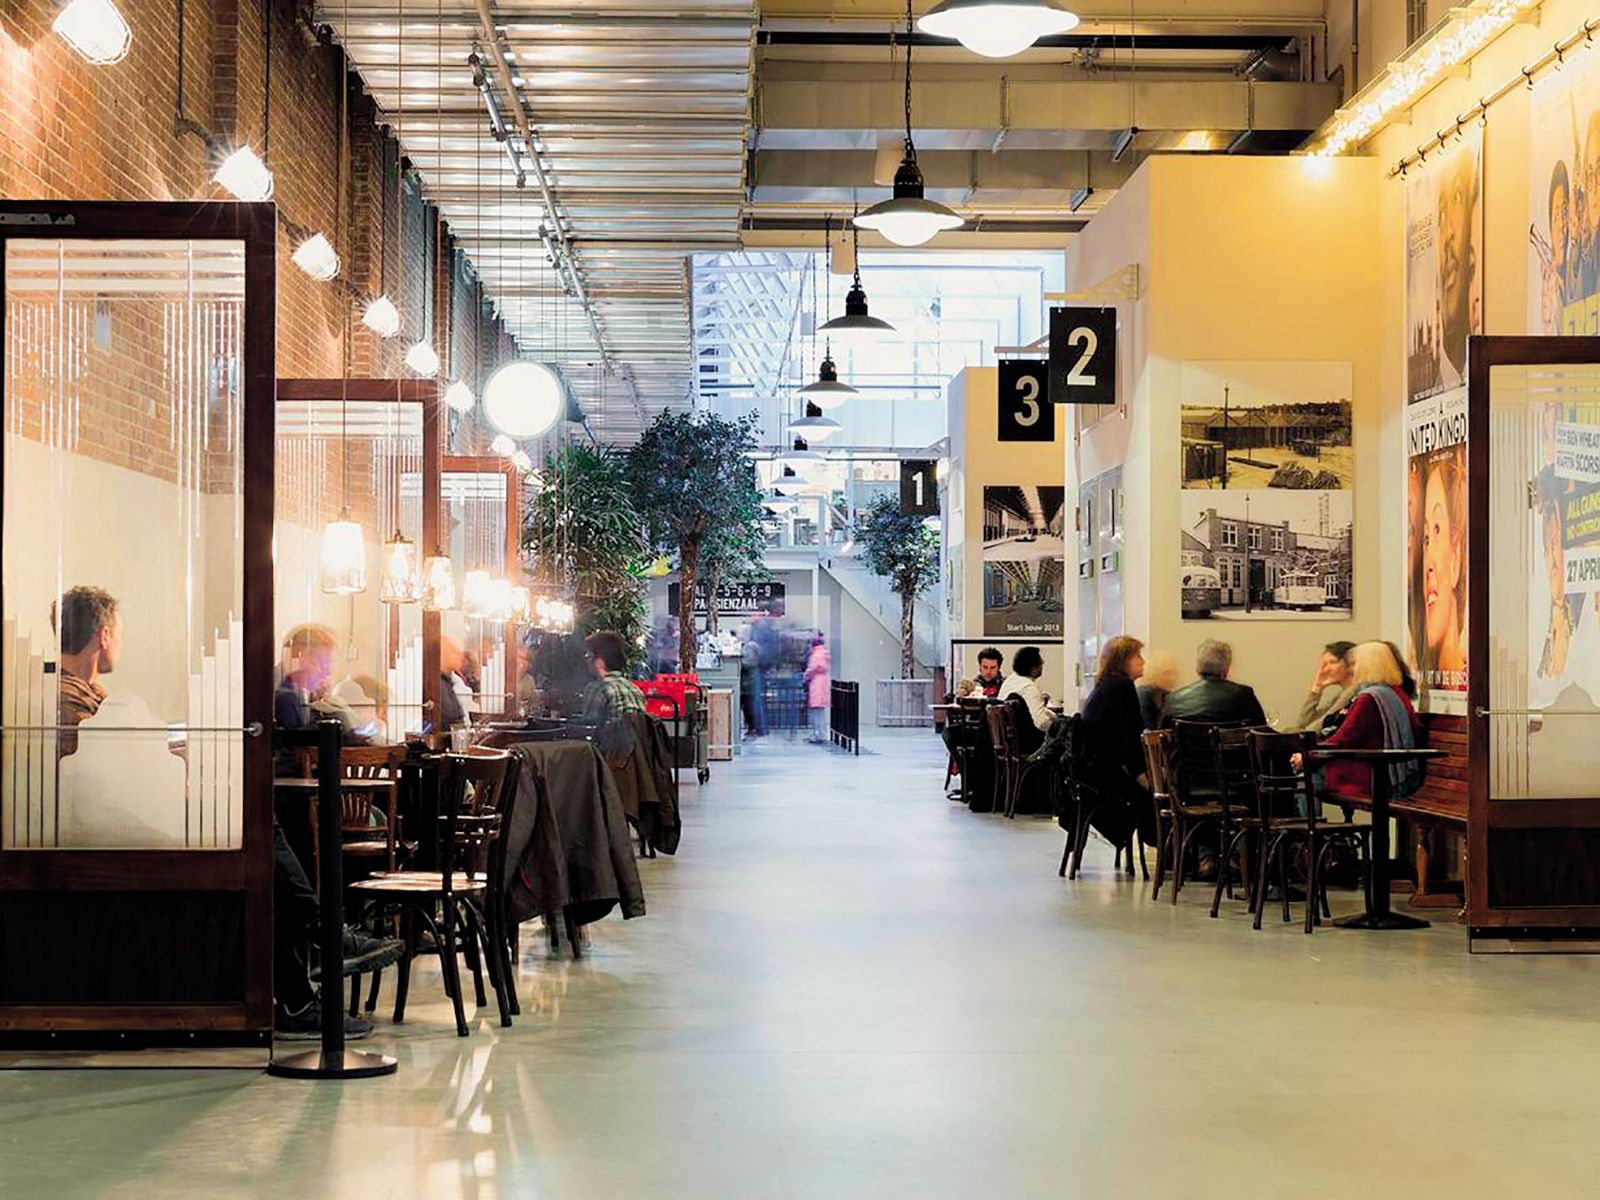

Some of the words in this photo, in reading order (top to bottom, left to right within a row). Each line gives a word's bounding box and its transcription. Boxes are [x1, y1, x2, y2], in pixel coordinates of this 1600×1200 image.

[1066, 326, 1098, 387] 2
[1013, 375, 1040, 428] 3
[911, 470, 924, 506] 1
[1567, 560, 1578, 583] 27
[694, 598, 759, 610] PASIENZAAL
